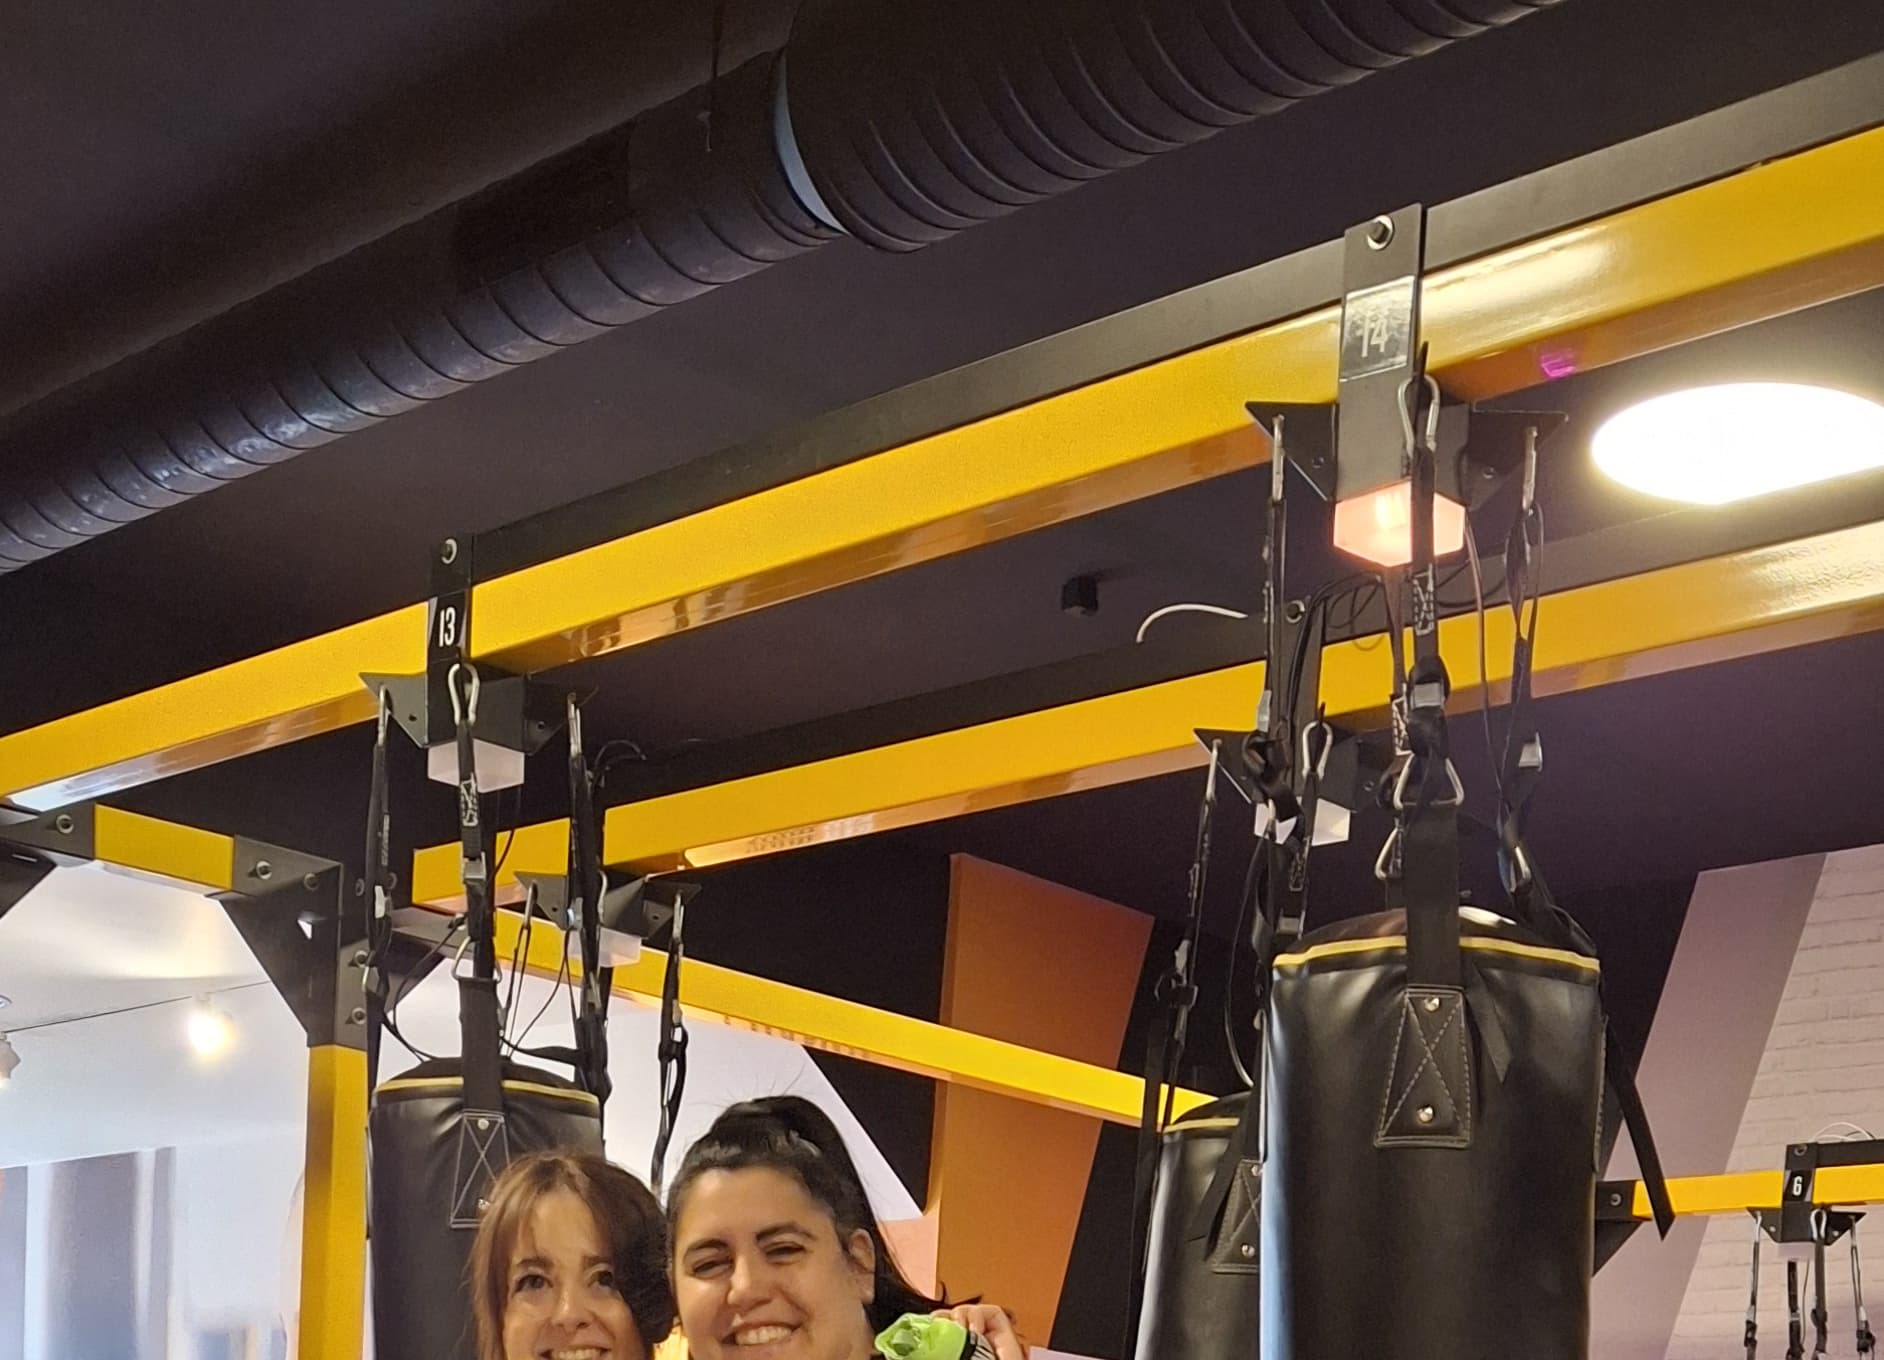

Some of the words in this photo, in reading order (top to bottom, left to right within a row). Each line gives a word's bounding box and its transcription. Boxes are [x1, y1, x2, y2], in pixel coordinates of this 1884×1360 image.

[1361, 317, 1389, 358] 14
[438, 606, 456, 647] 13
[1793, 1175, 1803, 1196] 6
